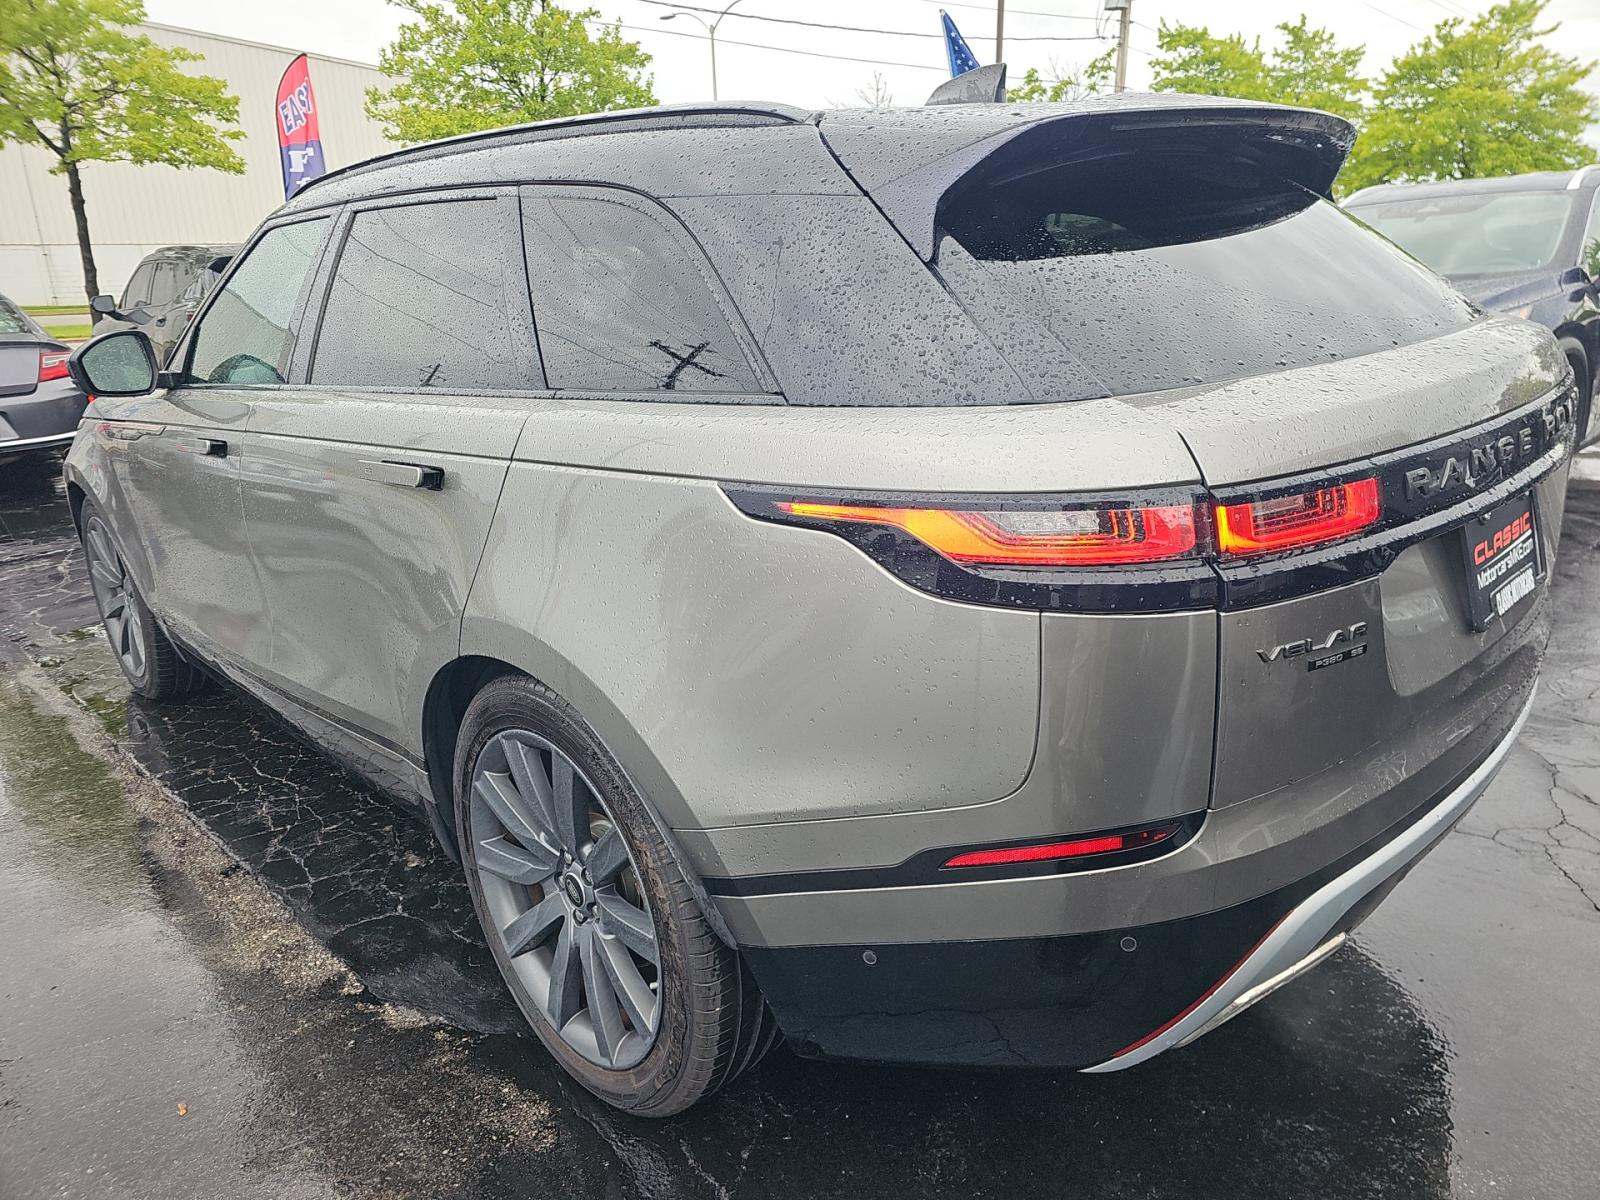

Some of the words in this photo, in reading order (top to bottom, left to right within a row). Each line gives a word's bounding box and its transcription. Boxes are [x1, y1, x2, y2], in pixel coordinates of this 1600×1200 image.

[278, 77, 313, 136] EASY
[1405, 427, 1533, 499] RANGE
[1474, 511, 1532, 566] CLASSIC
[1256, 621, 1368, 663] VELAR
